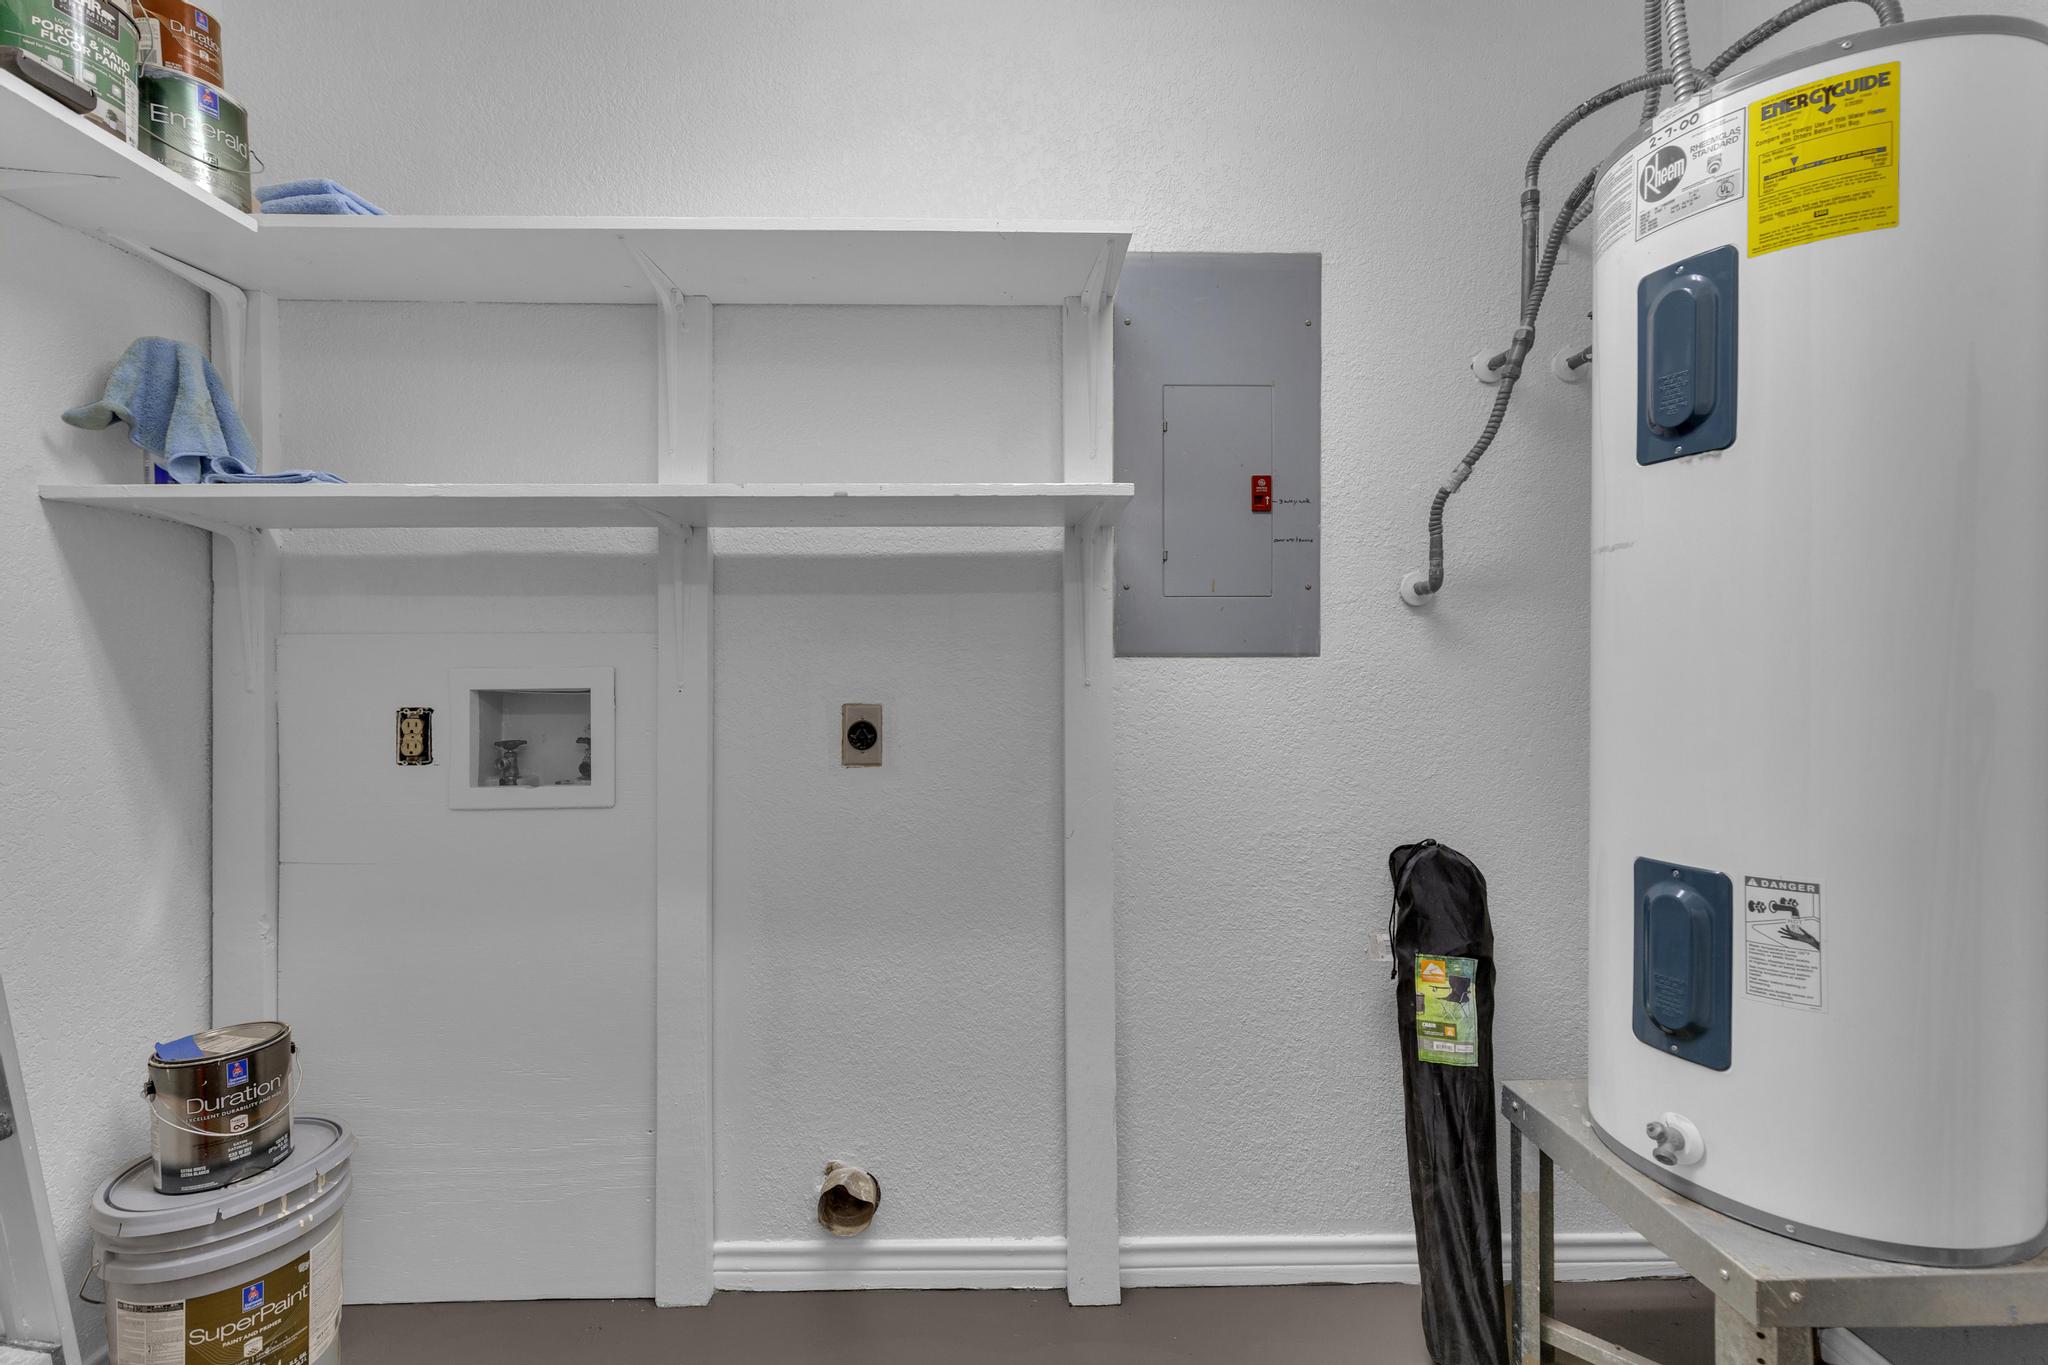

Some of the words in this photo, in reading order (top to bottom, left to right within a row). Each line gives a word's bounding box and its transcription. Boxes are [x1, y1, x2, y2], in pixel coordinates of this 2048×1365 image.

[31, 15, 85, 44] PORCH
[89, 40, 99, 51] &
[102, 46, 130, 72] PATIO
[40, 29, 91, 57] FLOOR
[95, 53, 126, 77] PAINT
[1761, 71, 1891, 121] ENERGYGUIDE
[150, 102, 248, 160] Emerald
[1692, 135, 1739, 160] STANDARD
[1792, 125, 1813, 135] Energy
[1644, 152, 1685, 200] Rheem
[1761, 880, 1816, 892] DANGER
[185, 1112, 220, 1123] EXCELLENT
[221, 1102, 258, 1117] DURABILITY
[186, 1075, 282, 1115] Duration
[189, 1284, 309, 1346] SuperPaint
[222, 1337, 244, 1348] PAINT
[243, 1330, 259, 1340] AND
[259, 1318, 282, 1333] PRIMER
